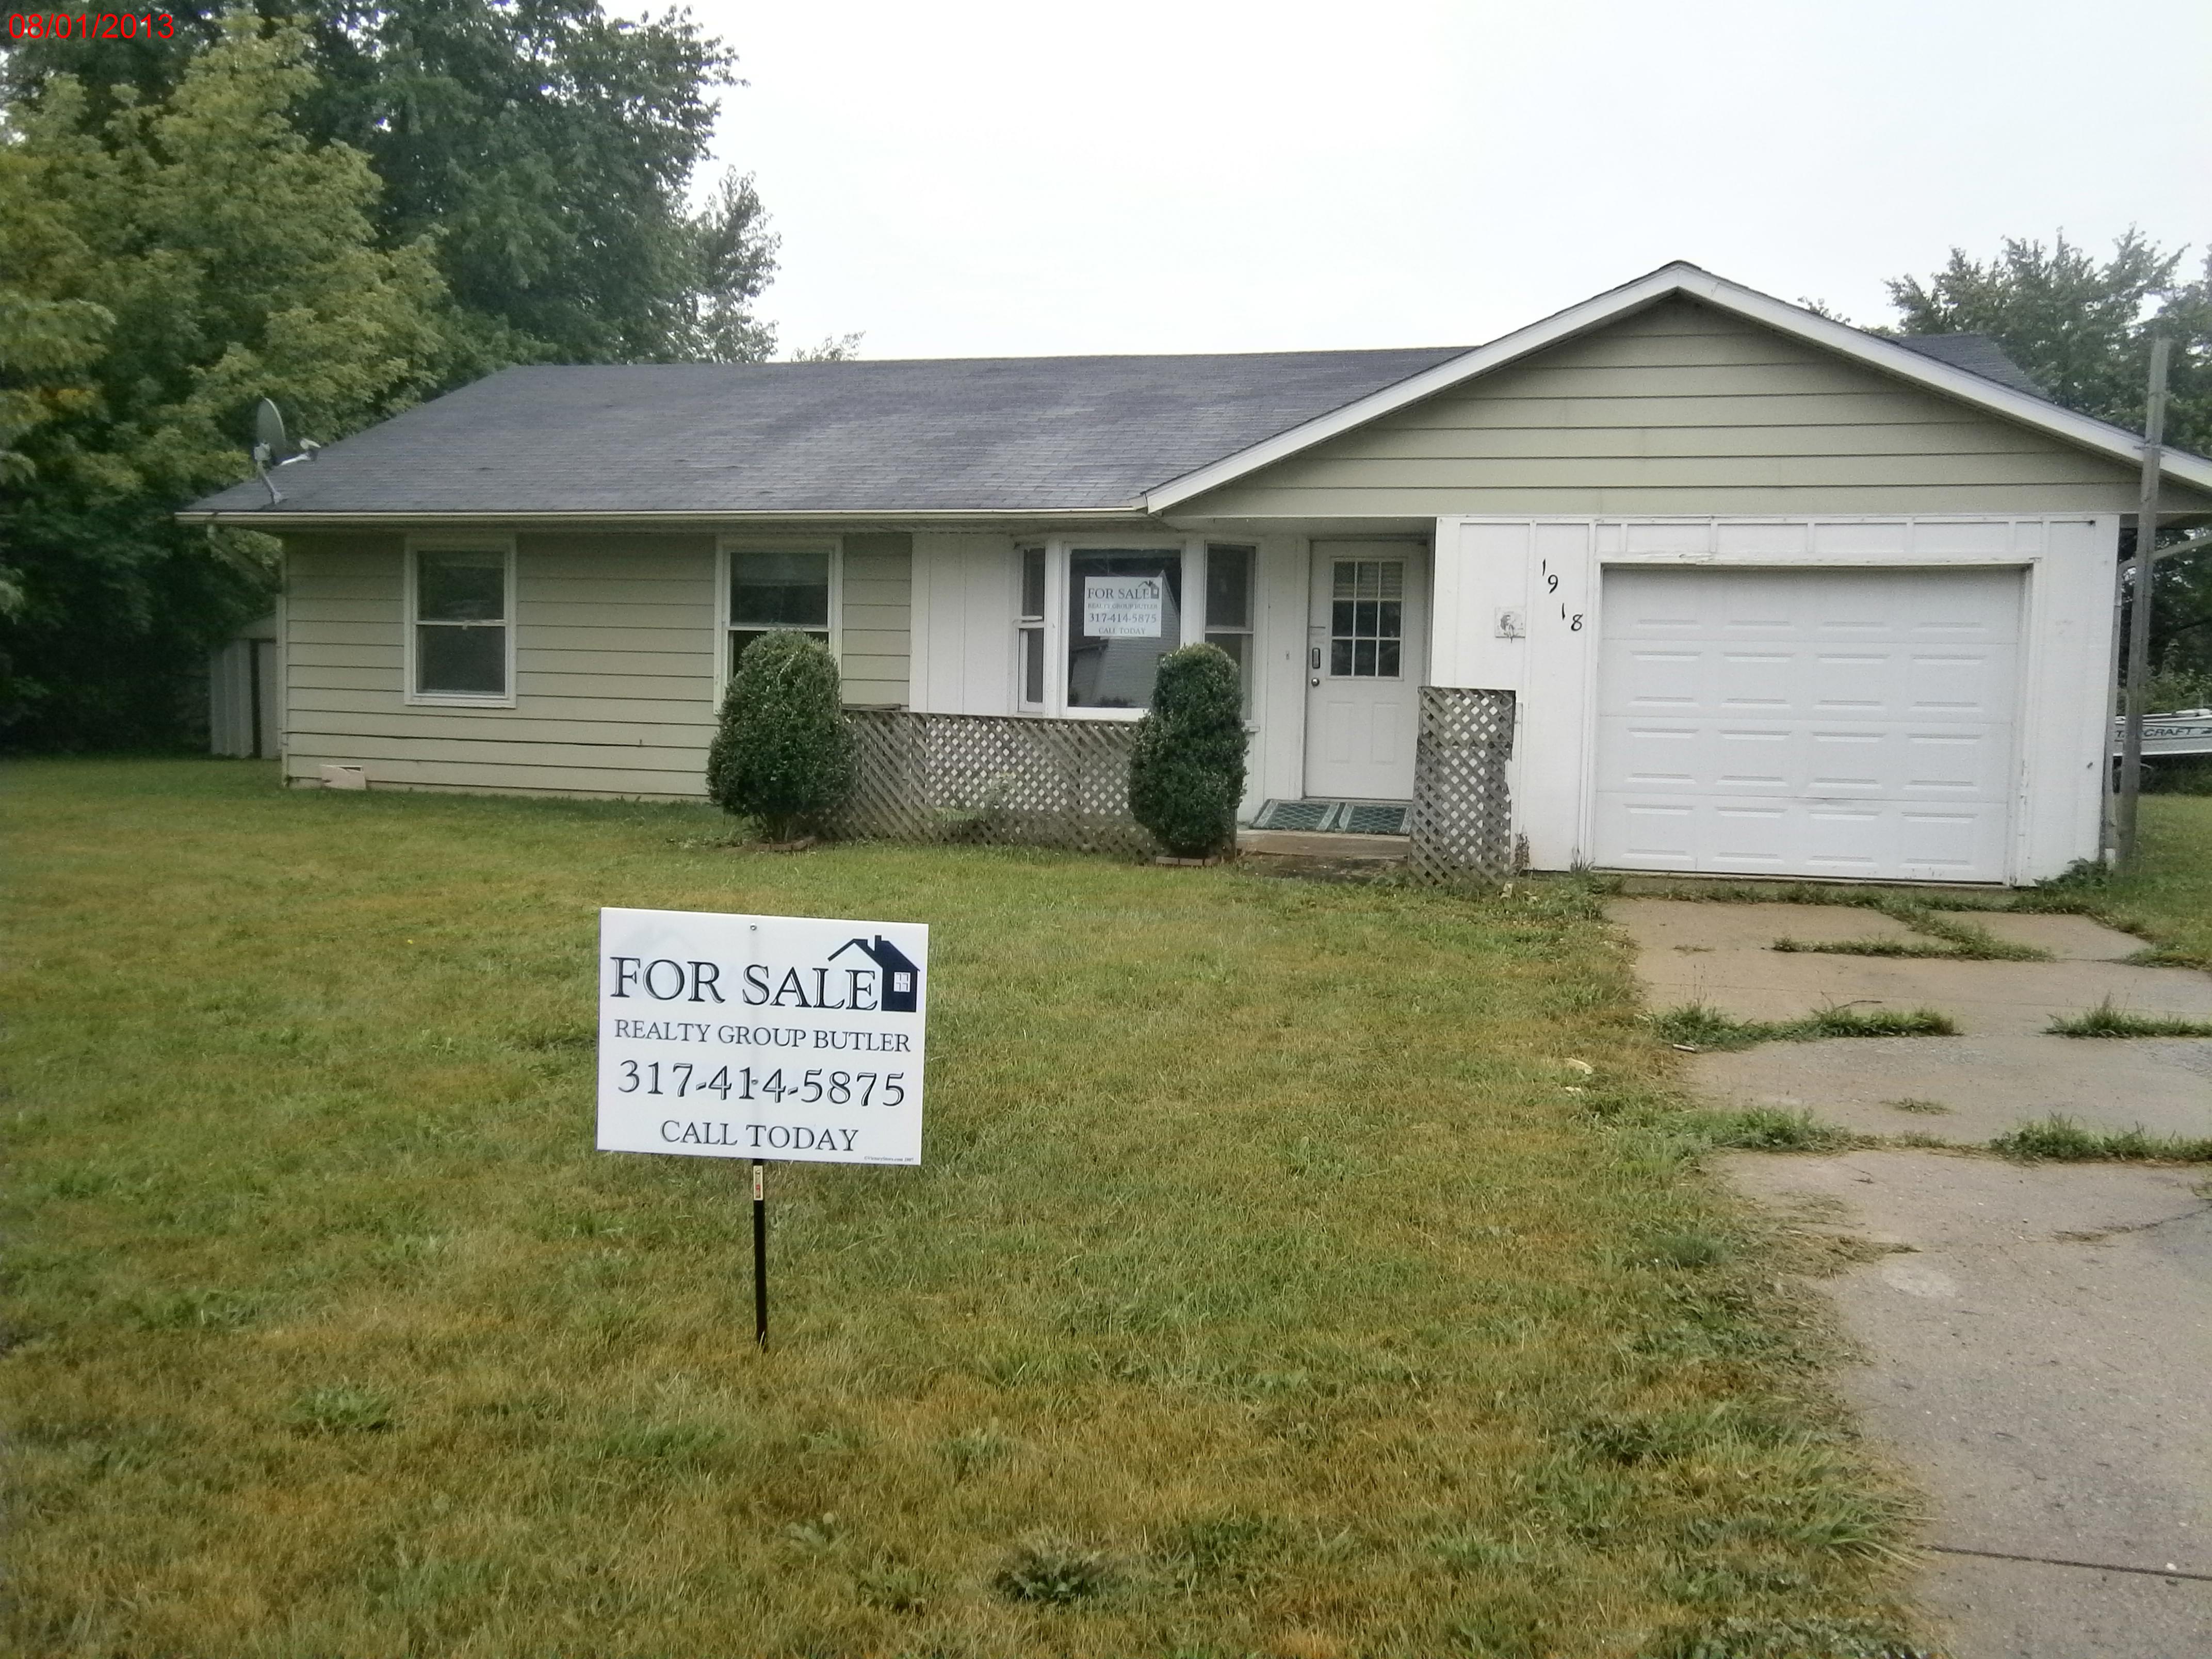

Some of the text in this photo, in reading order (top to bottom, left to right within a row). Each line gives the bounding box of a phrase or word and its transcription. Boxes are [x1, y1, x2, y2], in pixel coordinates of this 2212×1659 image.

[1087, 588, 1150, 600] FOR SALE
[1542, 559, 1584, 631] 1918
[1089, 613, 1157, 623] 317-414-5875
[610, 956, 878, 1011] FOR SALE
[614, 1019, 911, 1052] REALTY GROUP BUTLER
[618, 1059, 905, 1107] 317-414-5875
[660, 1120, 858, 1151] CALL TODAY
